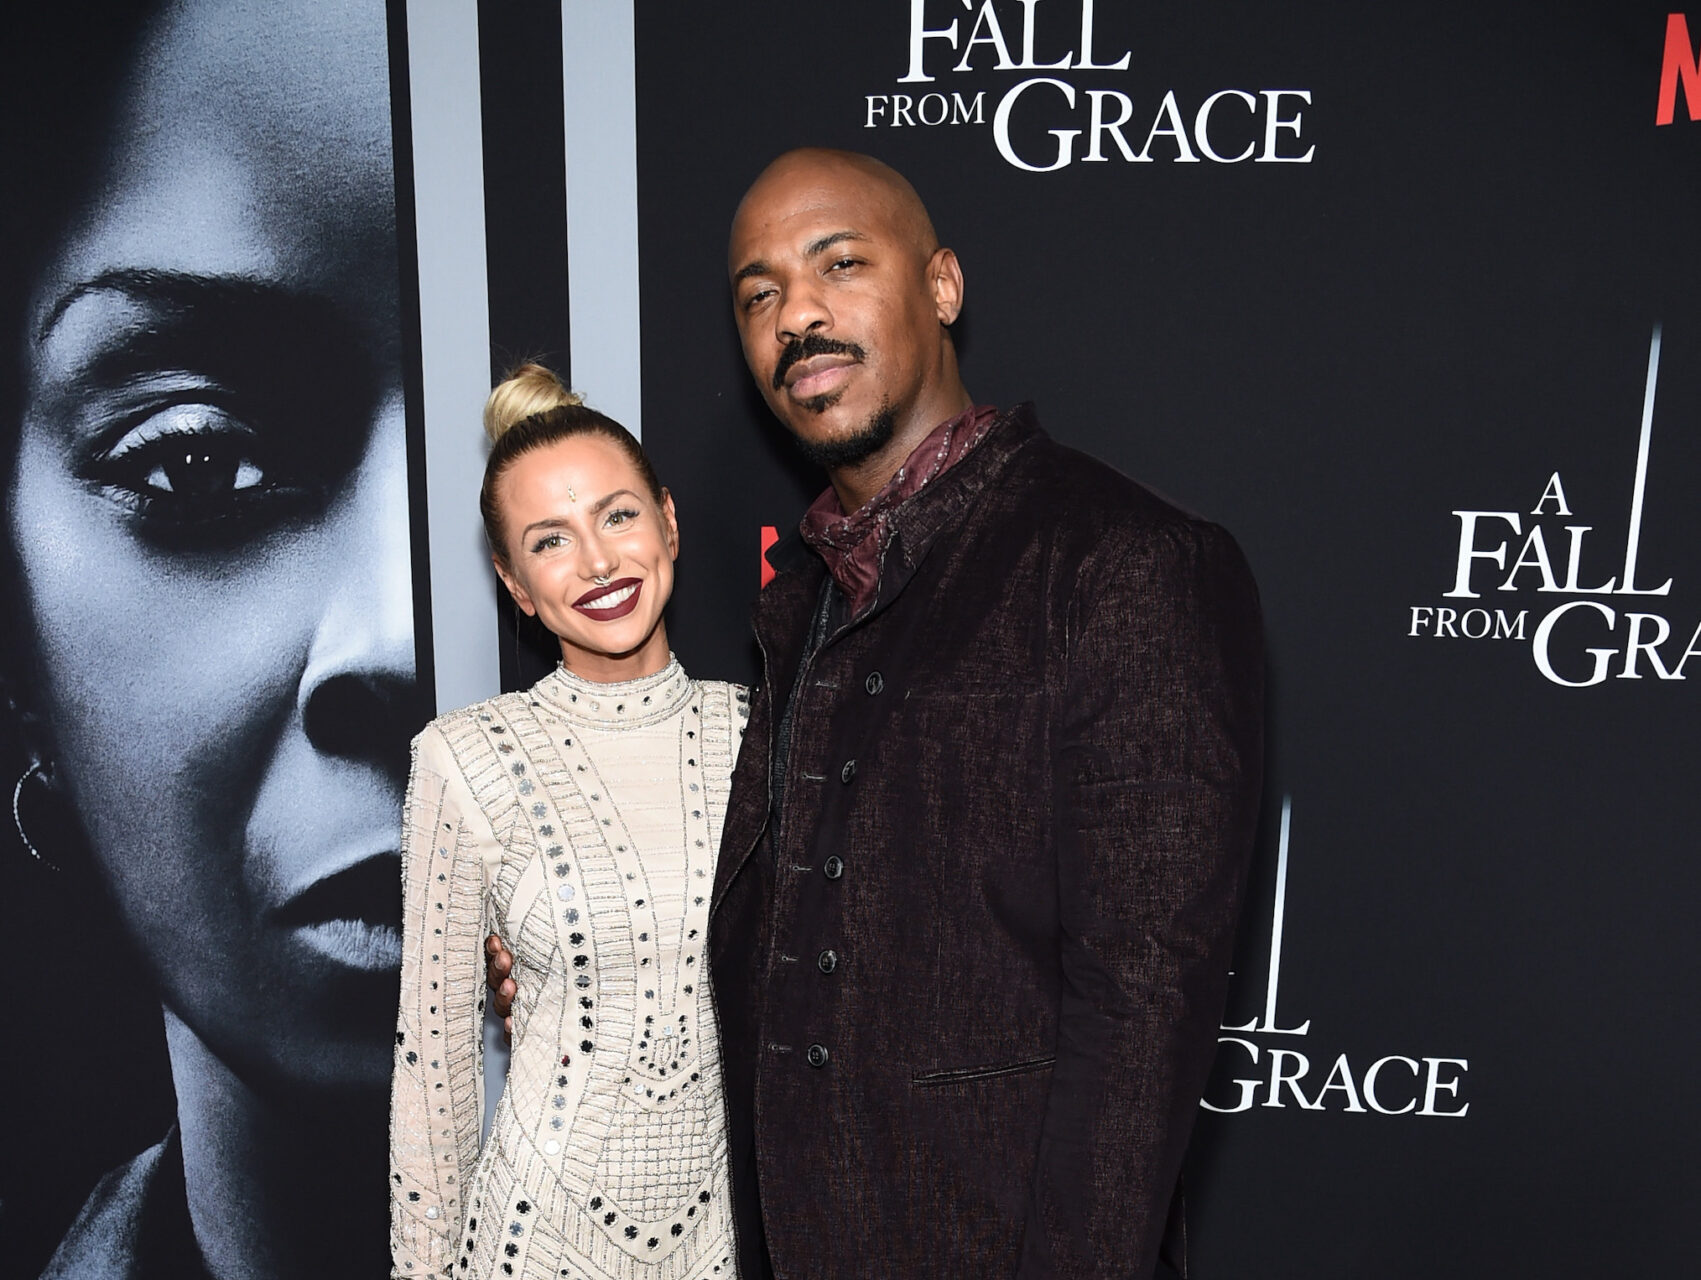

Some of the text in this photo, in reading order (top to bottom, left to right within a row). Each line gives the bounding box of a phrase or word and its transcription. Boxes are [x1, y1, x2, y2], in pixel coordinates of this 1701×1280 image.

[897, 0, 1131, 83] FALL
[864, 78, 1316, 172] FROM GRACE
[1442, 325, 1673, 598] FALL
[1530, 471, 1573, 516] A
[1407, 606, 1529, 640] FROM
